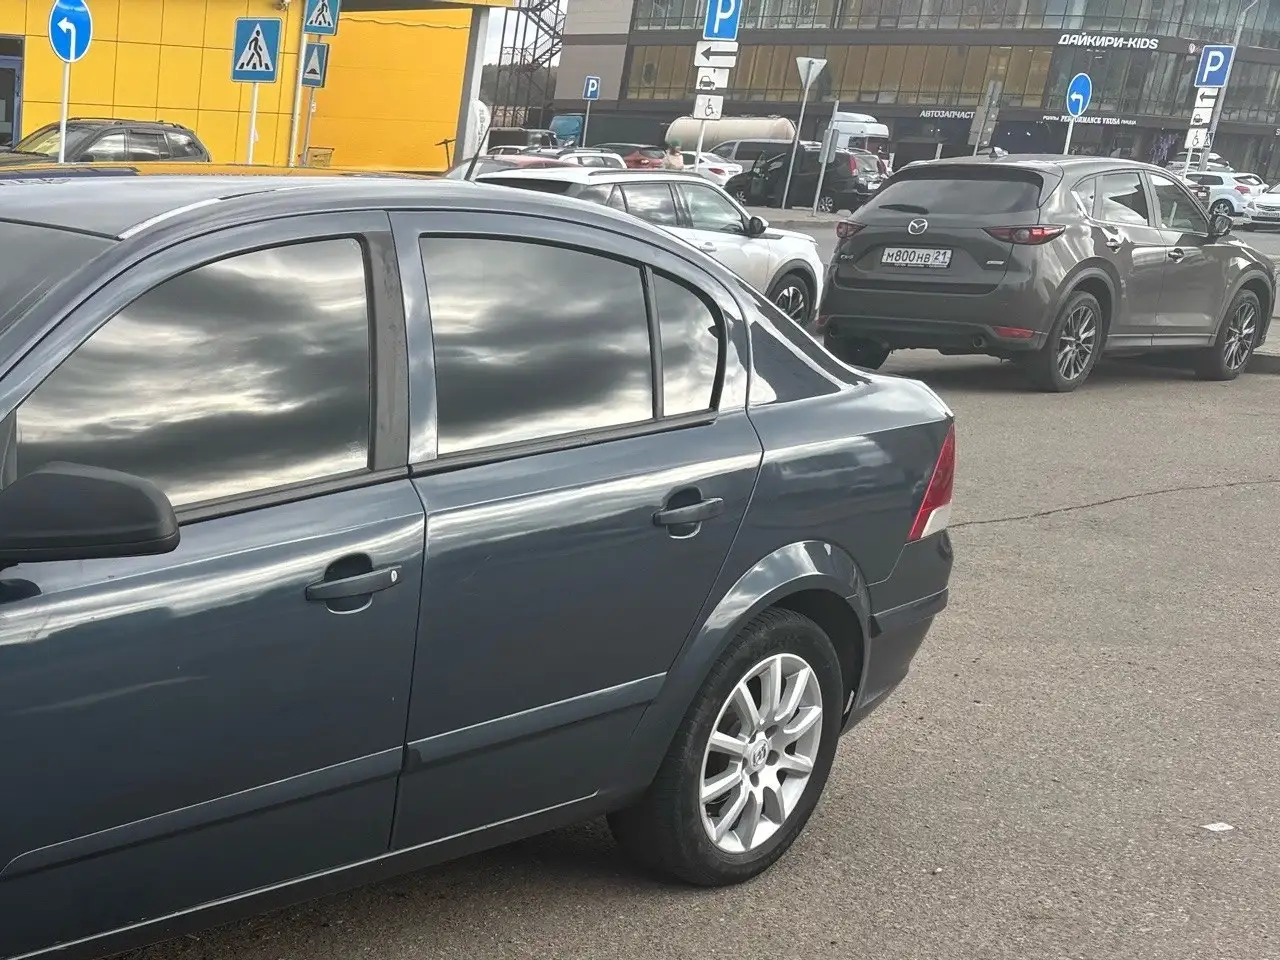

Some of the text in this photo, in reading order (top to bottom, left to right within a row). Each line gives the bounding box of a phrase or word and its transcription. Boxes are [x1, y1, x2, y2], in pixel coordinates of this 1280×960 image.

[714, 0, 735, 33] P
[1058, 32, 1159, 50] ДАЙКИРИ-KIDS
[1202, 50, 1225, 83] P
[587, 79, 598, 97] P
[920, 110, 975, 119] АВТОЗАПЧАСТ
[886, 249, 948, 263] М800НВ 21
